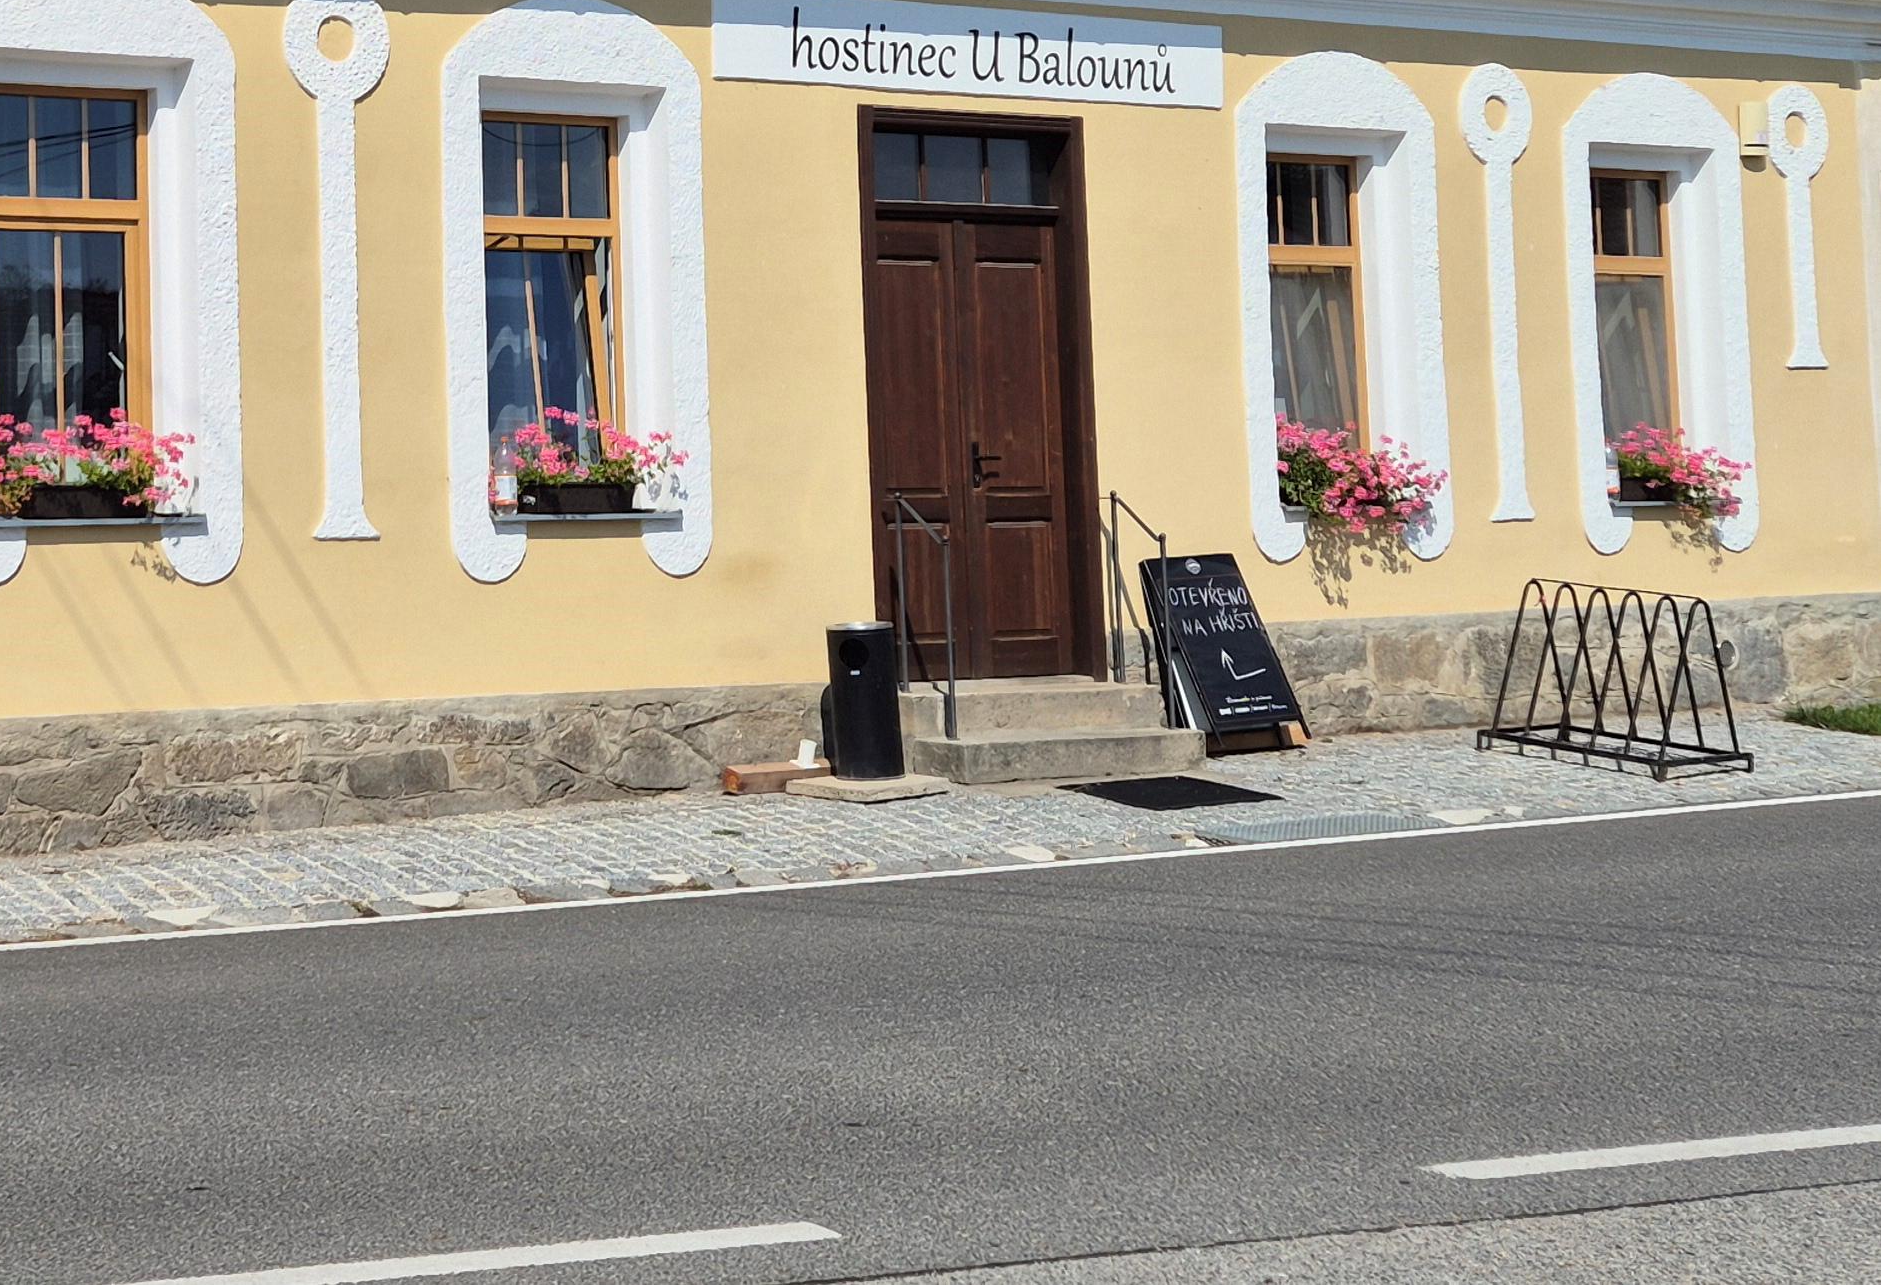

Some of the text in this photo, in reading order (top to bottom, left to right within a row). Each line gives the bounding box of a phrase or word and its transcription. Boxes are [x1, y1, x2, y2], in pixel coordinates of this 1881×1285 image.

[792, 6, 1176, 94] hostinec U Balounů
[1181, 618, 1208, 637] NA
